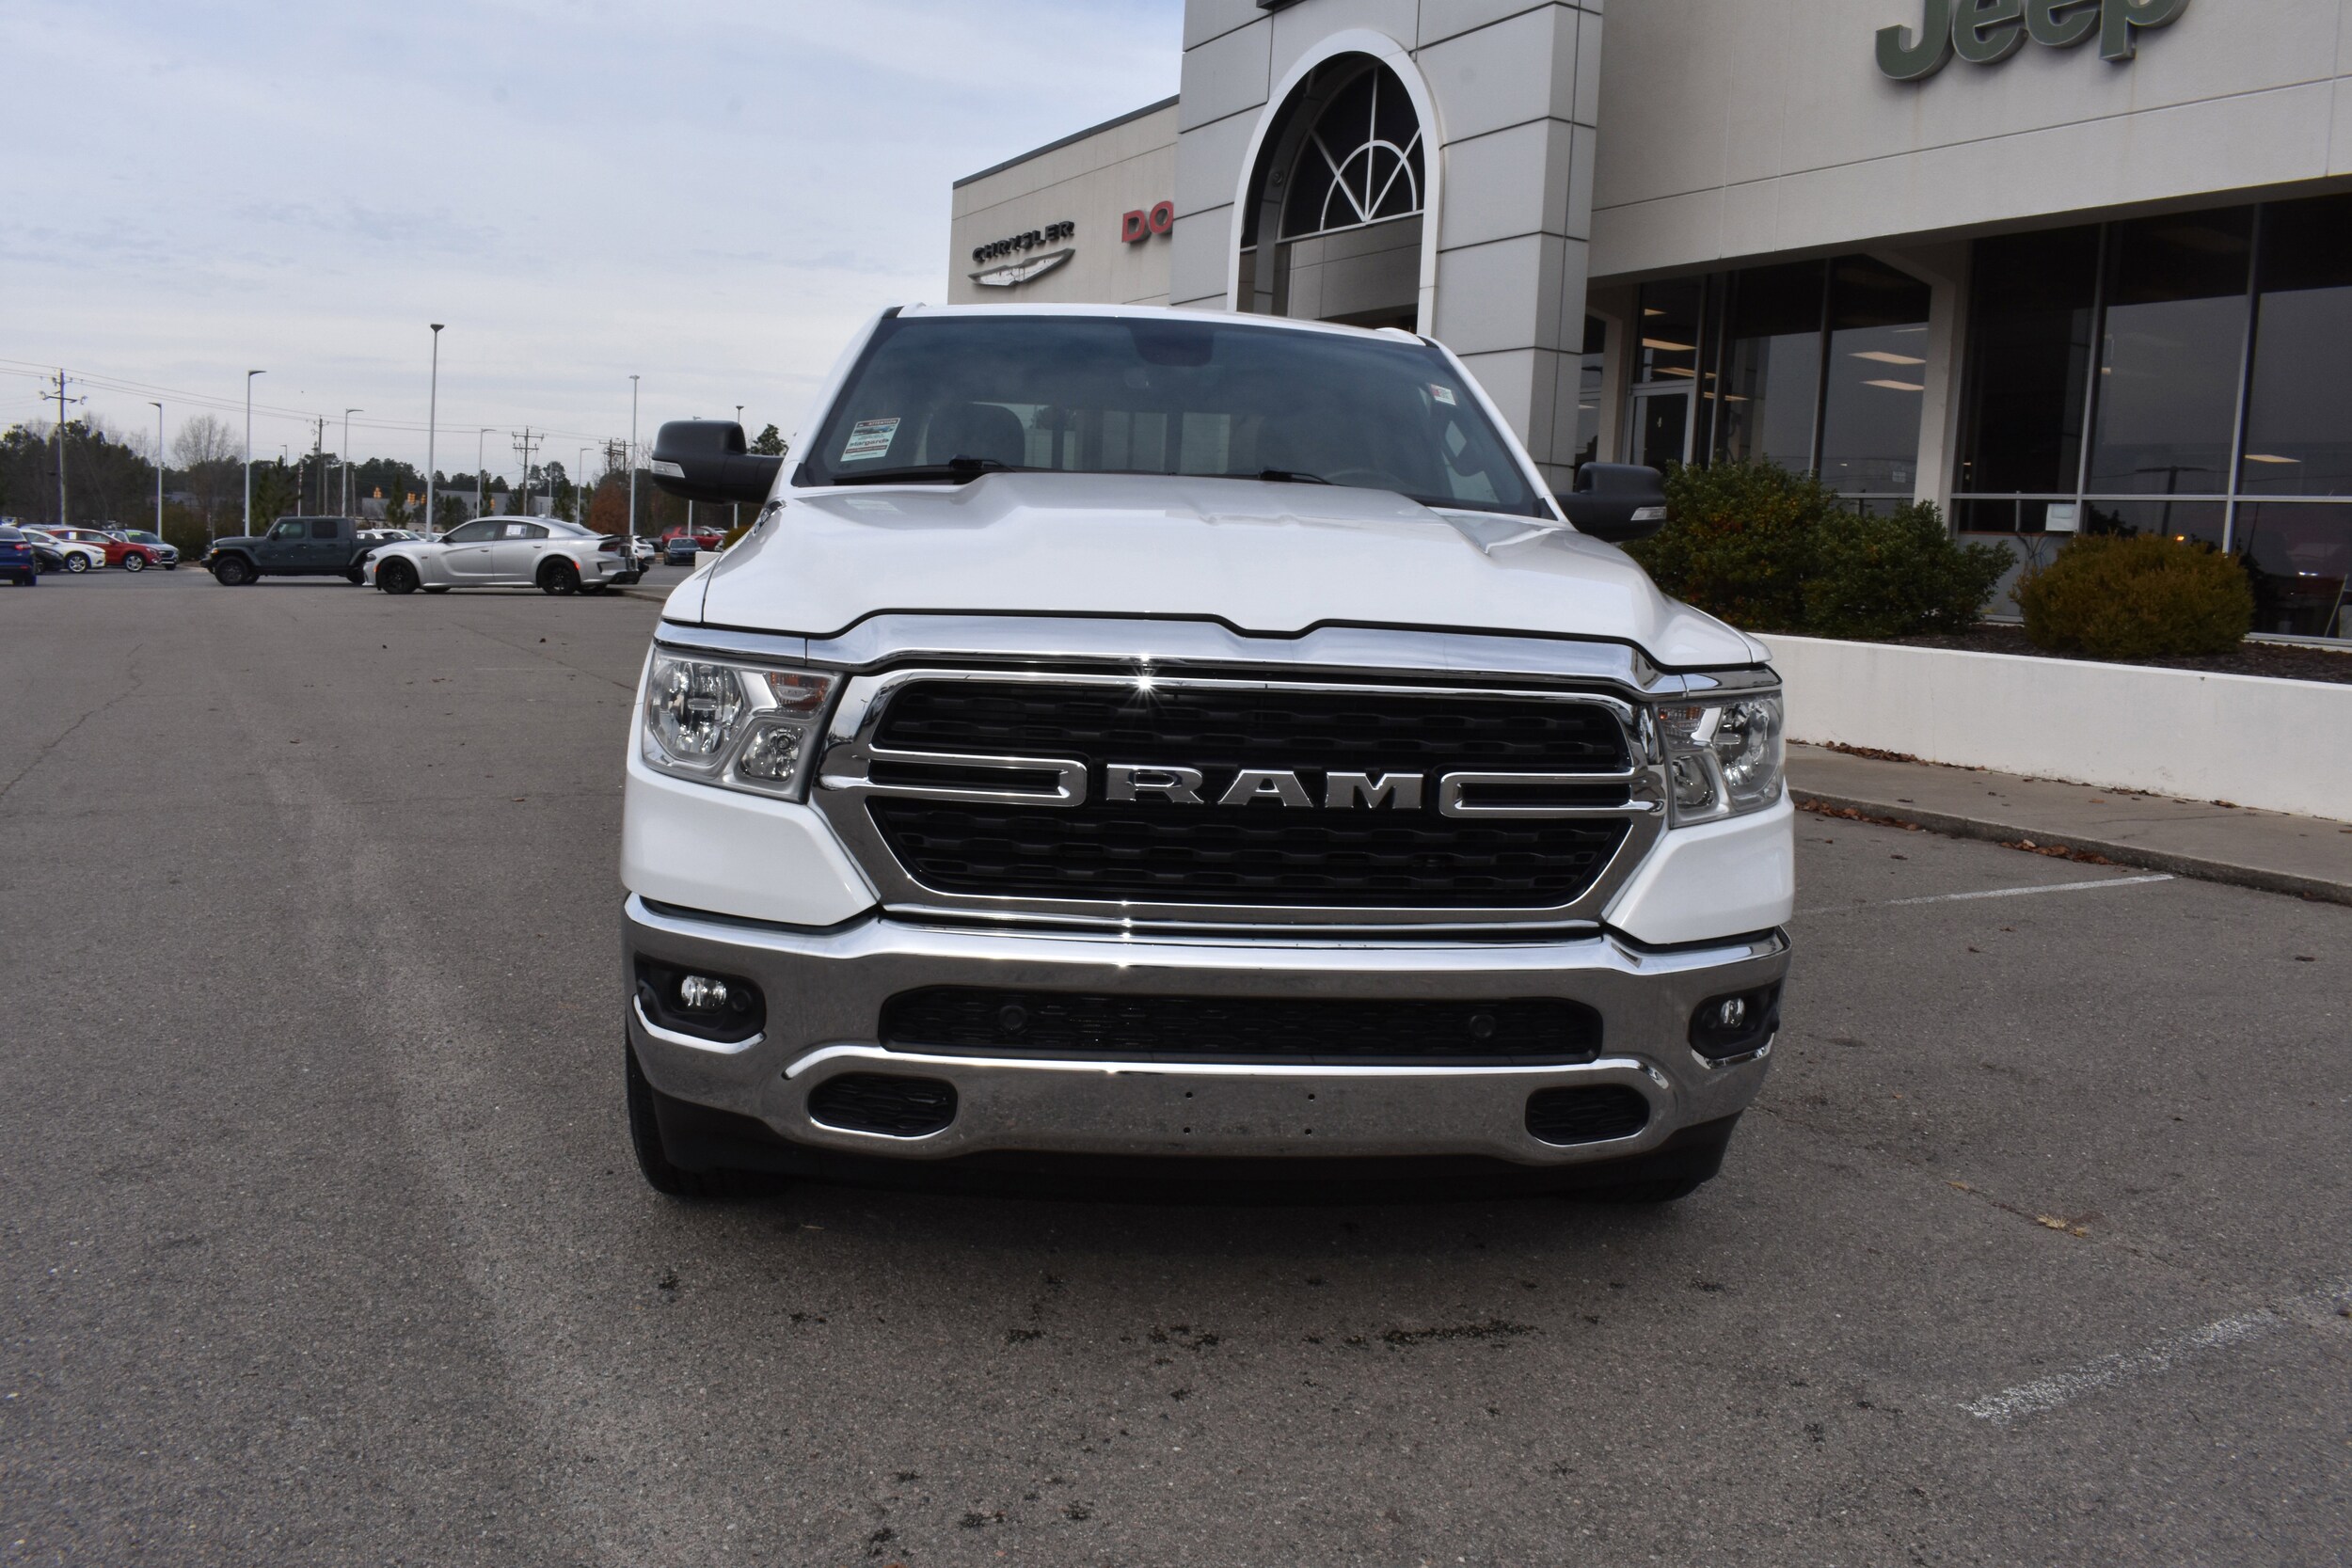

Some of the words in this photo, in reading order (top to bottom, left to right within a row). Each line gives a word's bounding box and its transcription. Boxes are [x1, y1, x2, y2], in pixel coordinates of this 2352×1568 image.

[1876, 0, 2190, 81] Jeep
[972, 220, 1075, 262] CHRYSLER
[1121, 200, 1174, 244] DO
[1105, 763, 1424, 809] RAM
